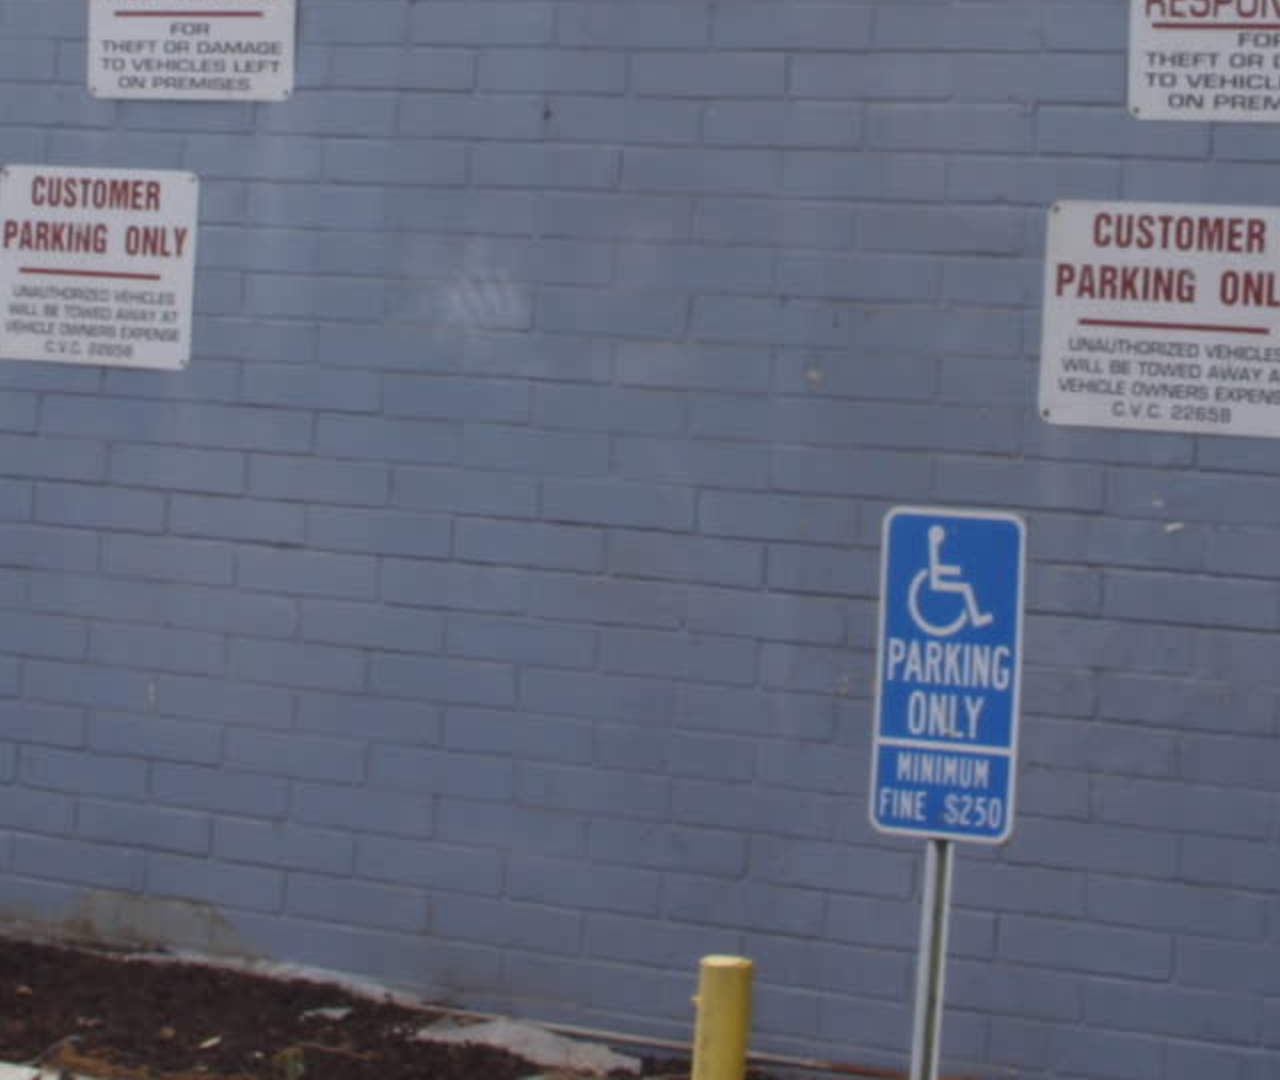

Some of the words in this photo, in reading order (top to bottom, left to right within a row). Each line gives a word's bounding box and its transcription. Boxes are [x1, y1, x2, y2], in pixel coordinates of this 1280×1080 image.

[170, 23, 209, 36] FOR
[102, 40, 157, 54] THEFT
[163, 42, 190, 54] OR
[197, 42, 282, 55] DAMAGE
[102, 58, 125, 70] TO
[132, 58, 226, 72] VEHICLES
[234, 60, 280, 73] LEFT
[1146, 52, 1219, 68] THEFT
[1229, 53, 1263, 68] OR
[118, 76, 145, 88] ON
[152, 76, 251, 90] PREMISES
[1146, 72, 1176, 87] TO
[1168, 94, 1203, 109] ON
[32, 176, 160, 211] CUSTOMER
[4, 220, 107, 254] PARKING
[125, 226, 188, 258] ONLY
[1093, 212, 1266, 254] CUSTOMER
[1056, 264, 1196, 303] PARKING
[1068, 337, 1200, 358] UNAUTHORIZED
[1061, 357, 1101, 373] WILL
[1110, 359, 1130, 374] BE
[1139, 360, 1201, 378] TOWED
[1208, 366, 1263, 382] AWAY
[1058, 378, 1125, 396] VEHICLE
[1131, 381, 1208, 400] OWNERS
[887, 637, 1010, 691] PARKING
[907, 690, 985, 739] ONLY
[896, 752, 990, 788] MINIMUM
[880, 788, 928, 821] FINE
